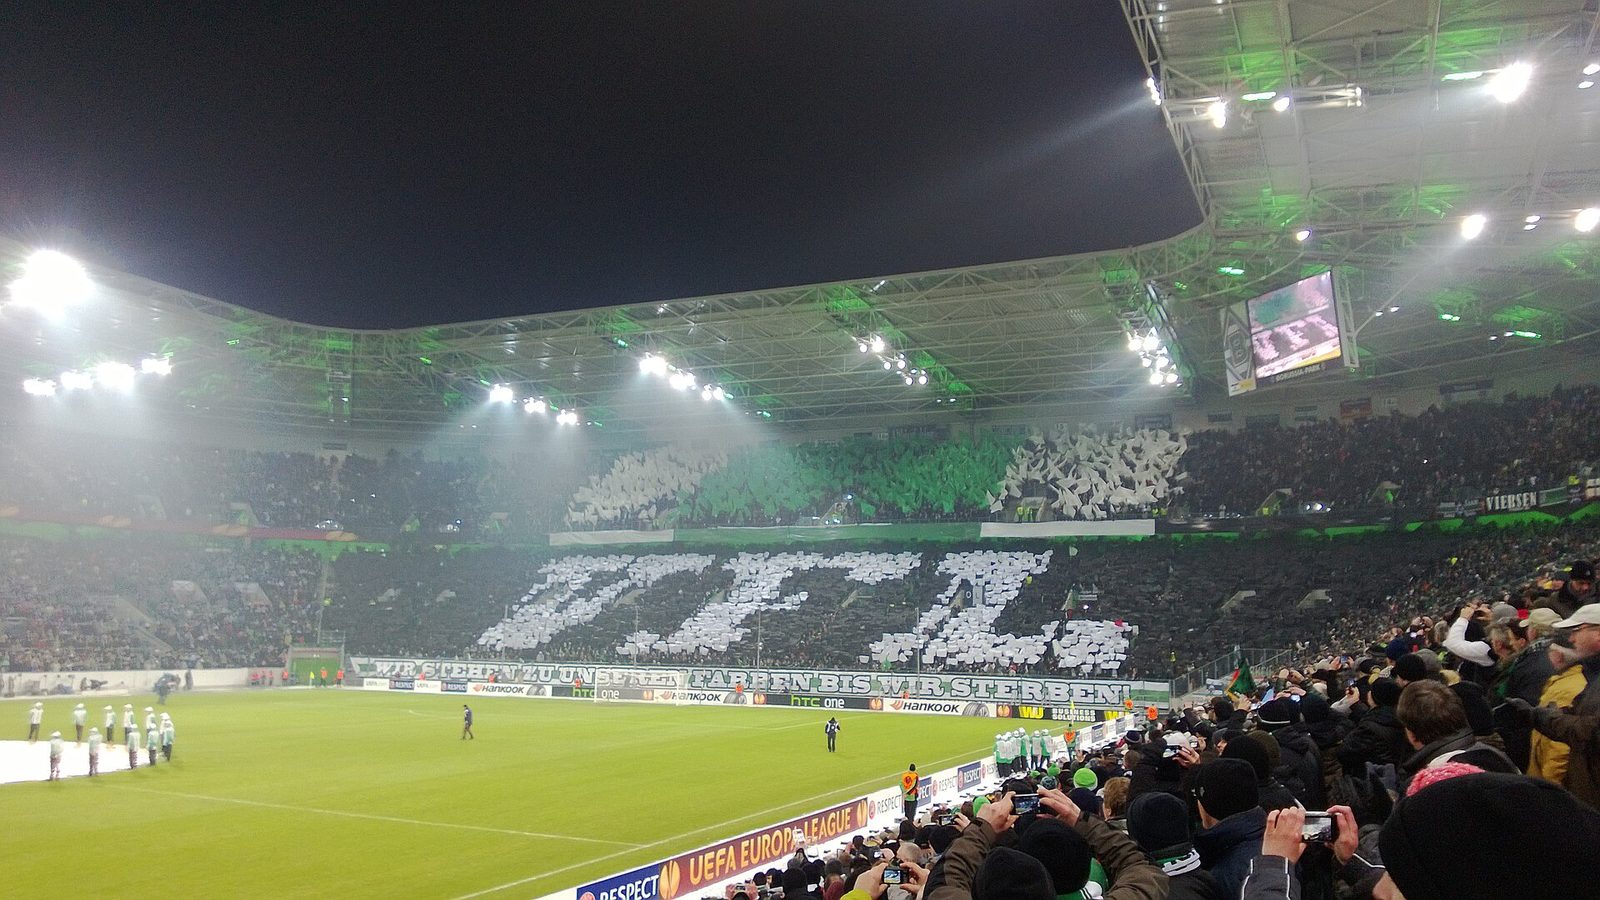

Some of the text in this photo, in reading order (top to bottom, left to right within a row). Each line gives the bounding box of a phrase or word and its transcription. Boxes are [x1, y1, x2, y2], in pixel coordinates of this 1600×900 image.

[1486, 492, 1537, 511] VIERSEN
[374, 661, 416, 678] WIR
[421, 661, 517, 682] STEHEN
[522, 665, 555, 683] ZU
[691, 670, 812, 692] FARBEN
[818, 674, 871, 694] BIS
[878, 676, 945, 698] WIR
[950, 678, 1131, 705] STERBEN!
[601, 689, 620, 699] one
[824, 697, 845, 708] one
[1018, 706, 1044, 719] WU
[1052, 707, 1096, 716] BUSINESS
[1052, 713, 1096, 722] SOLUTIONS
[690, 845, 737, 885] UEFA
[803, 807, 852, 843] LEAGUE
